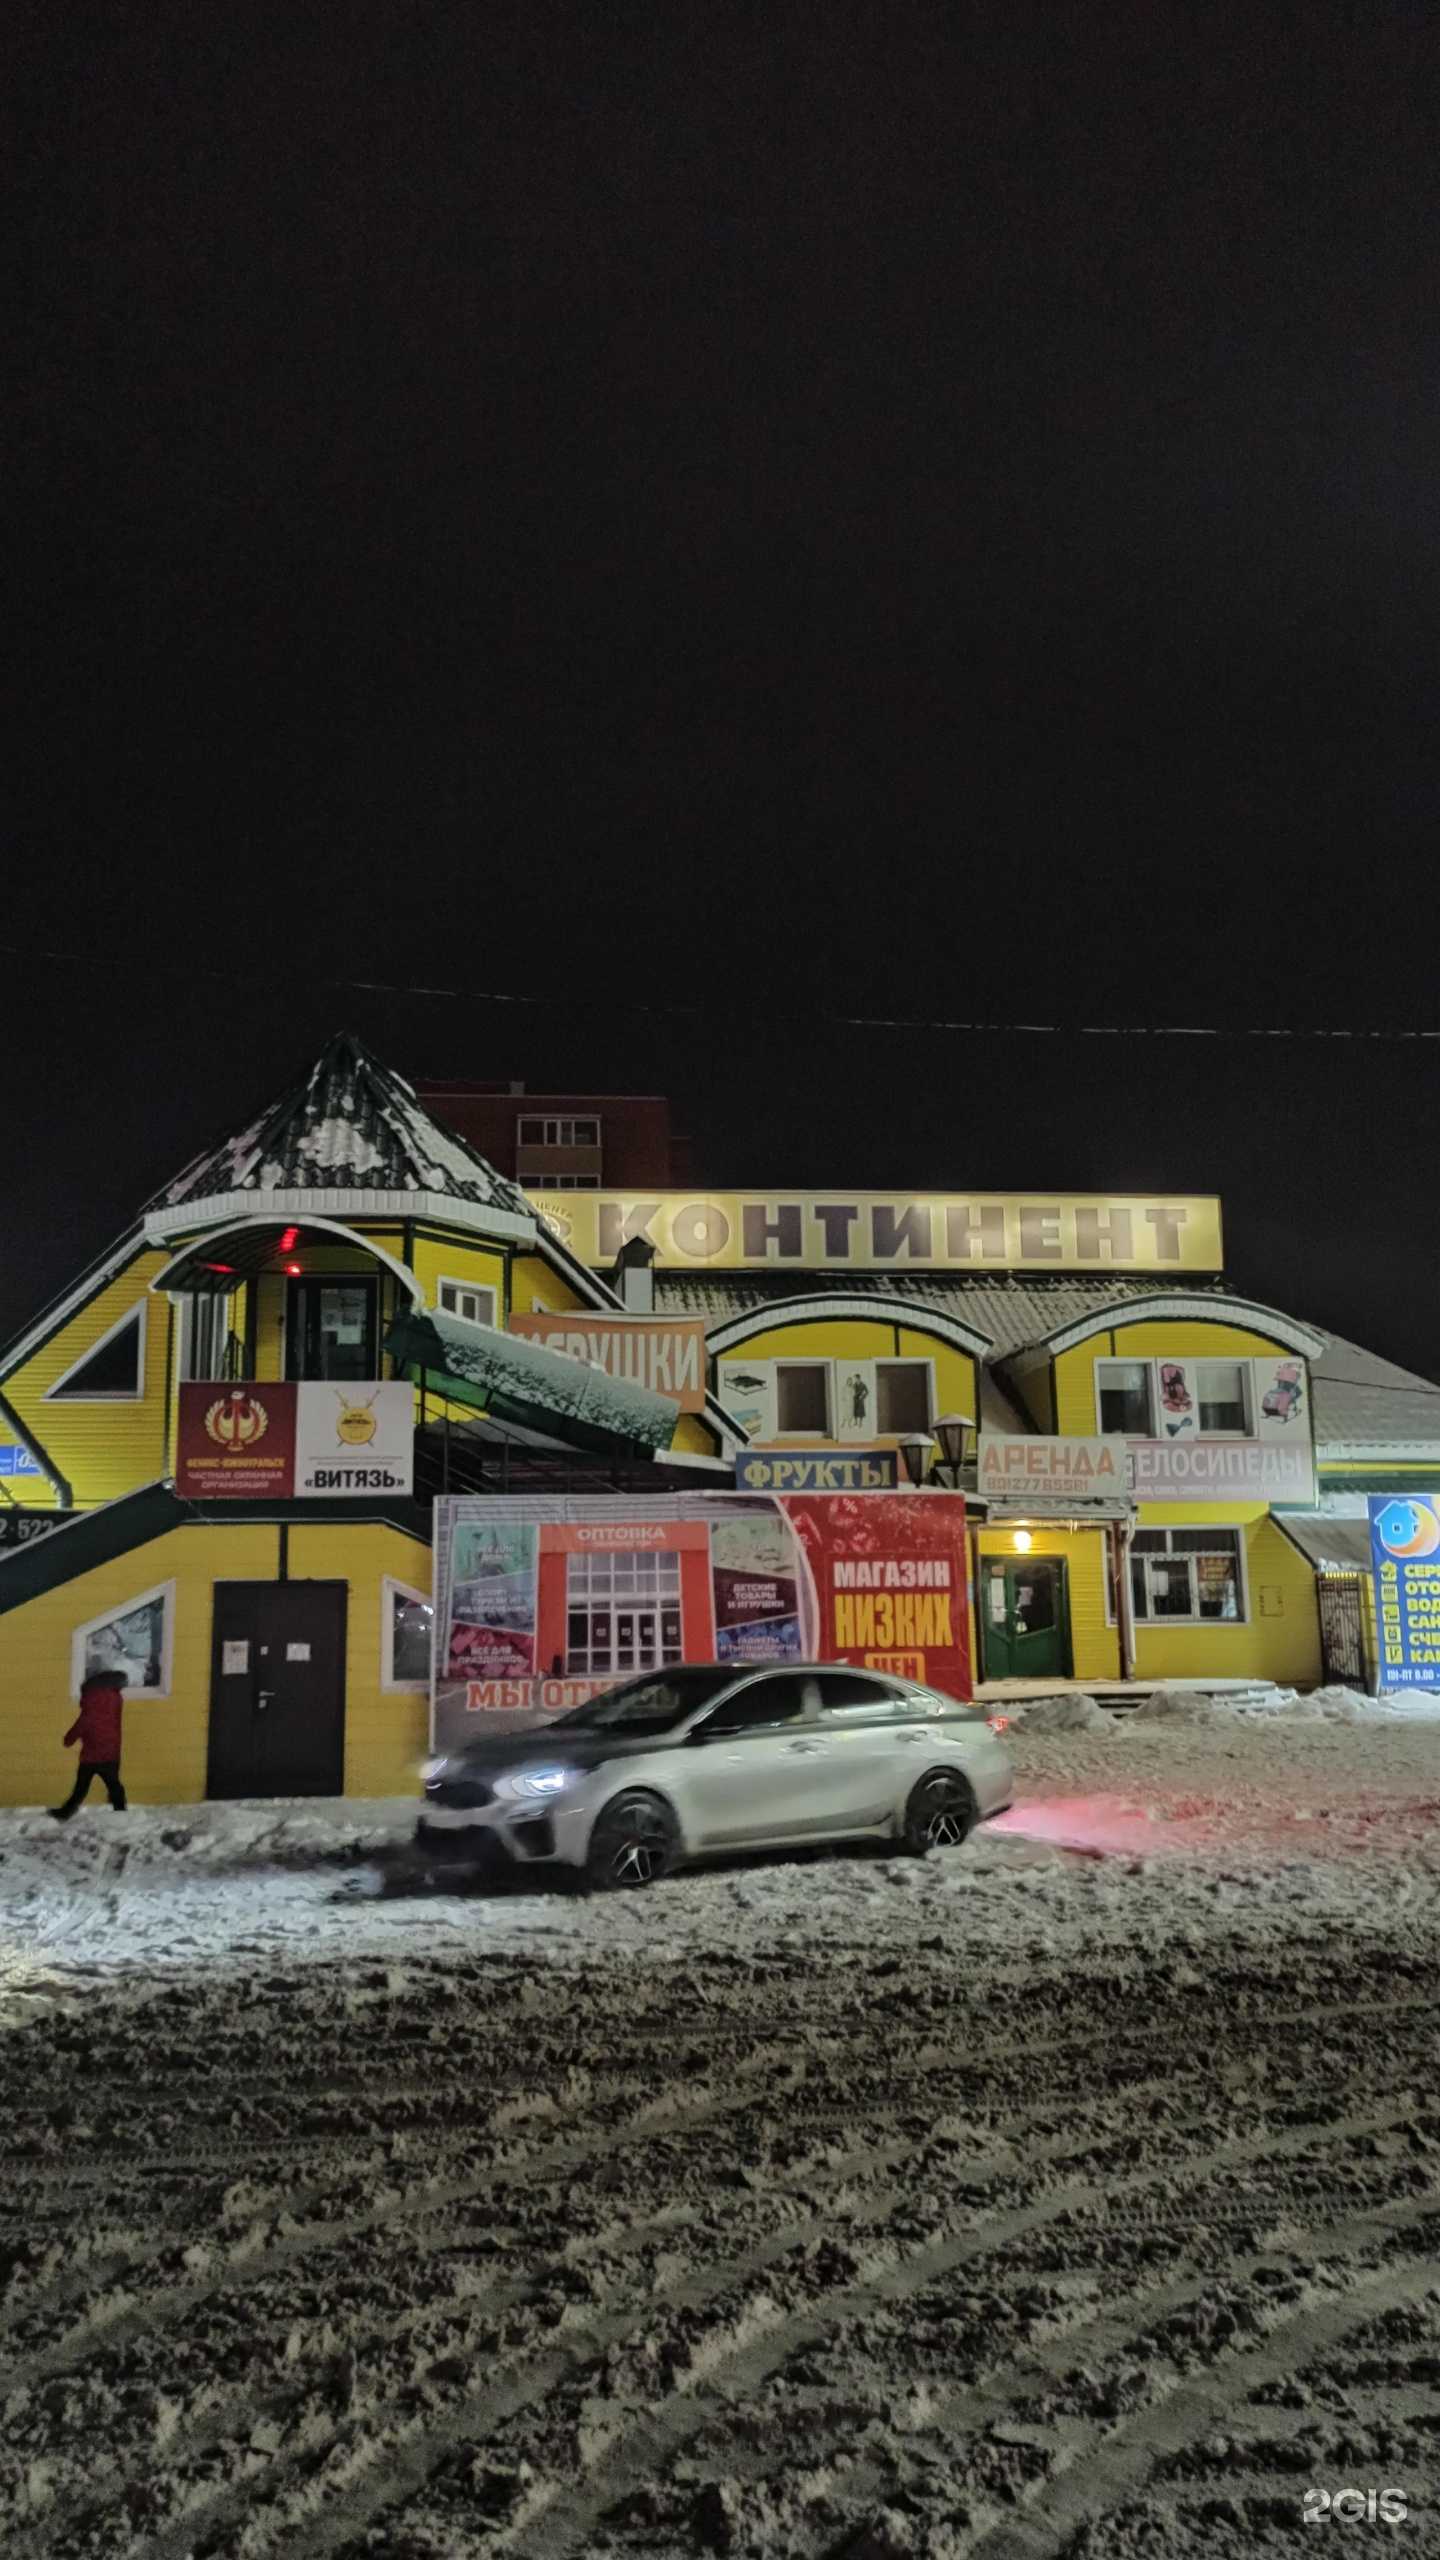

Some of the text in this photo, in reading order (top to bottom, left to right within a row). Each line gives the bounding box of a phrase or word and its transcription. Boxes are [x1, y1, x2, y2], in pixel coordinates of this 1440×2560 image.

[599, 1204, 1187, 1260] КОНТИНЕНТ
[982, 1443, 1115, 1475] АРЕНДА
[304, 1470, 405, 1488] «ВИТЯЗЬ»
[743, 1460, 892, 1488] ФРУКТЫ
[576, 1527, 666, 1541] ОПТОВКА
[833, 1560, 951, 1588] МАГАЗИН
[834, 1593, 953, 1648] НИЗКИХ
[467, 1680, 531, 1710] МЫ
